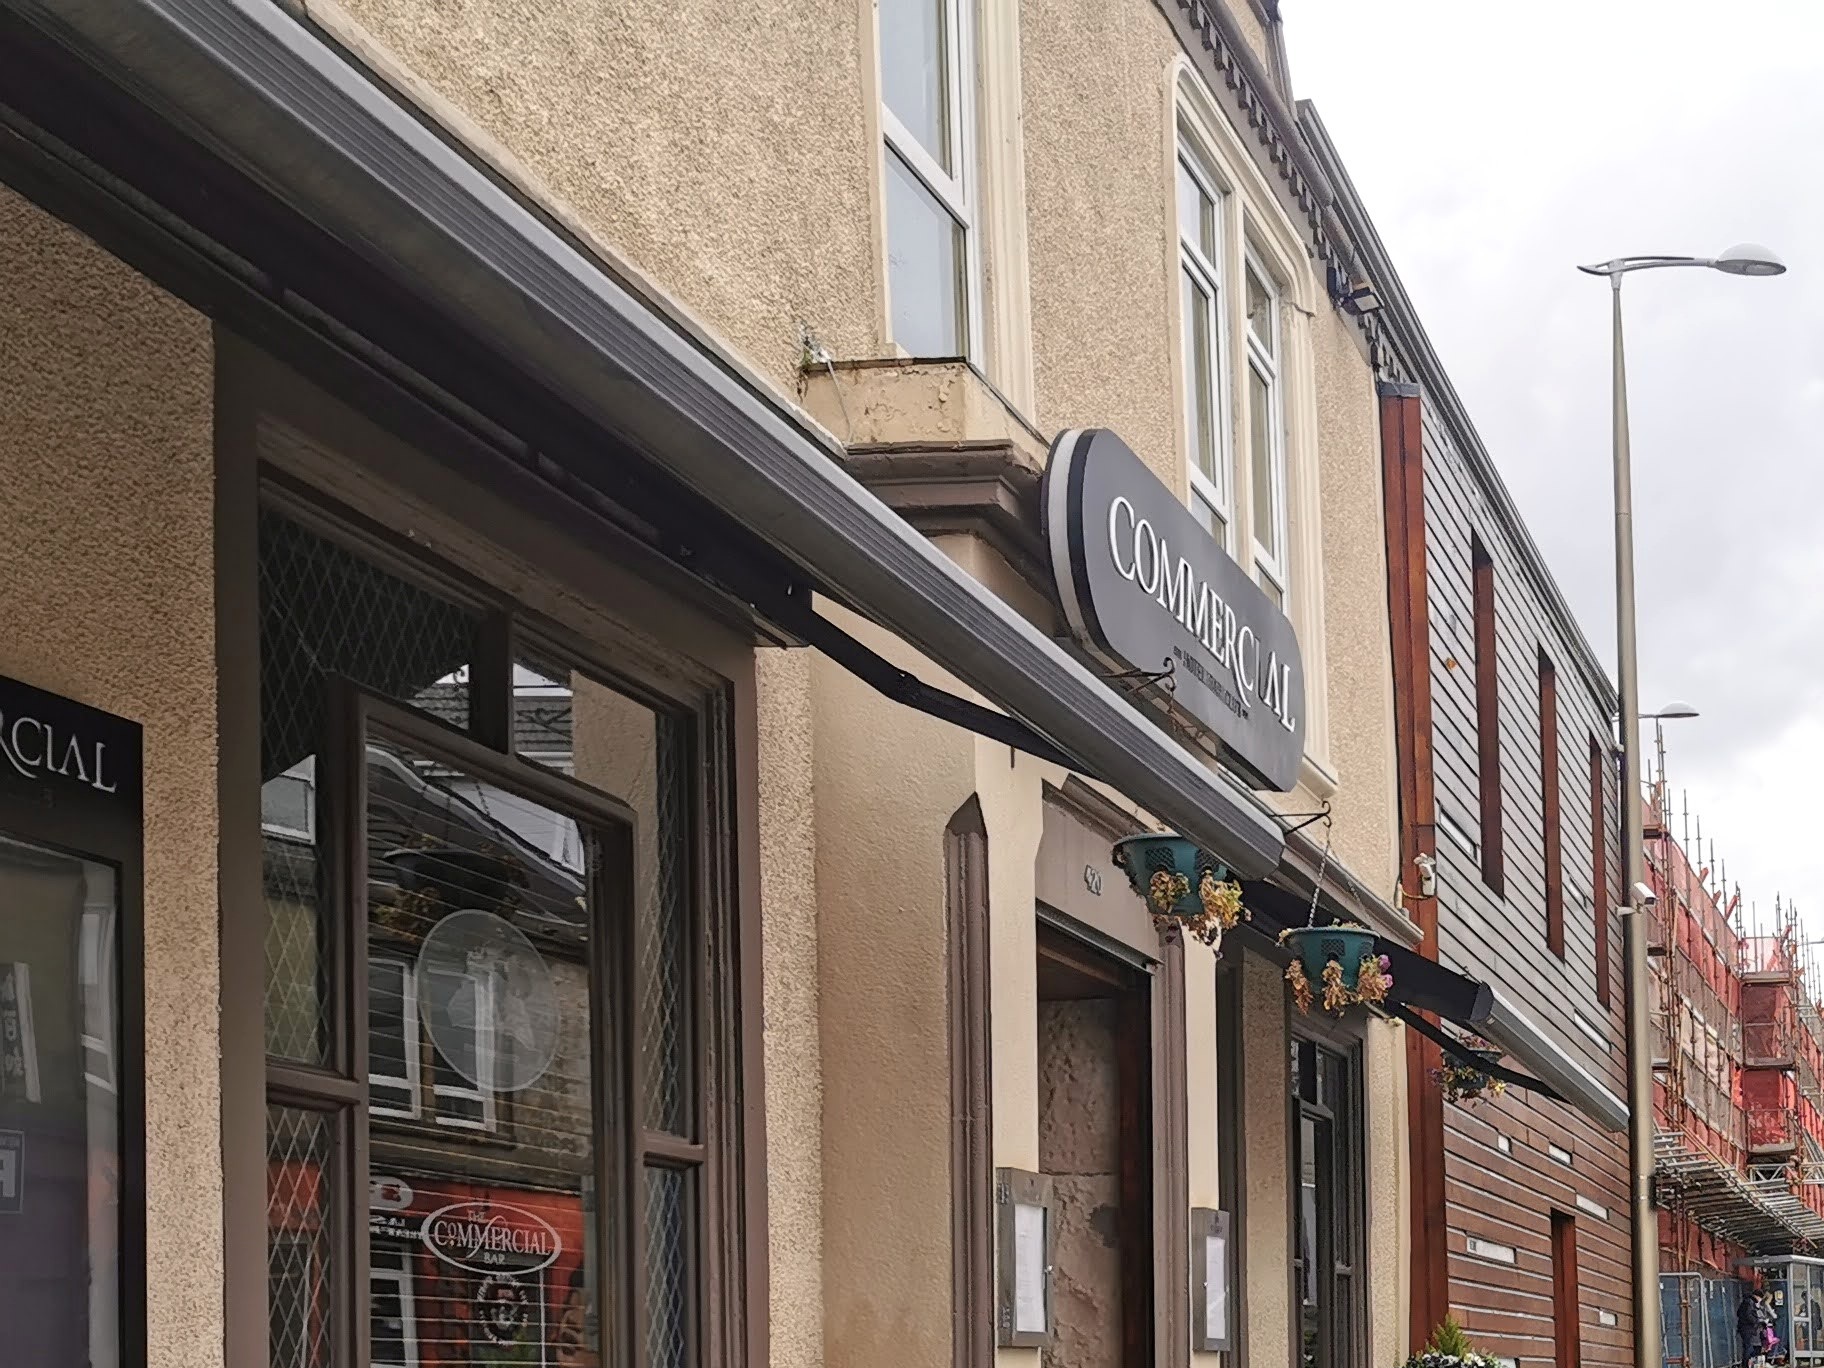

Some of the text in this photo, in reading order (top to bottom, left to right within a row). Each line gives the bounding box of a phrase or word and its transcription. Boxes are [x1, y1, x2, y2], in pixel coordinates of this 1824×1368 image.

[1108, 496, 1296, 733] COMMERCIAL
[434, 1215, 552, 1259] COMMERCIAL
[484, 1252, 506, 1266] BAR
